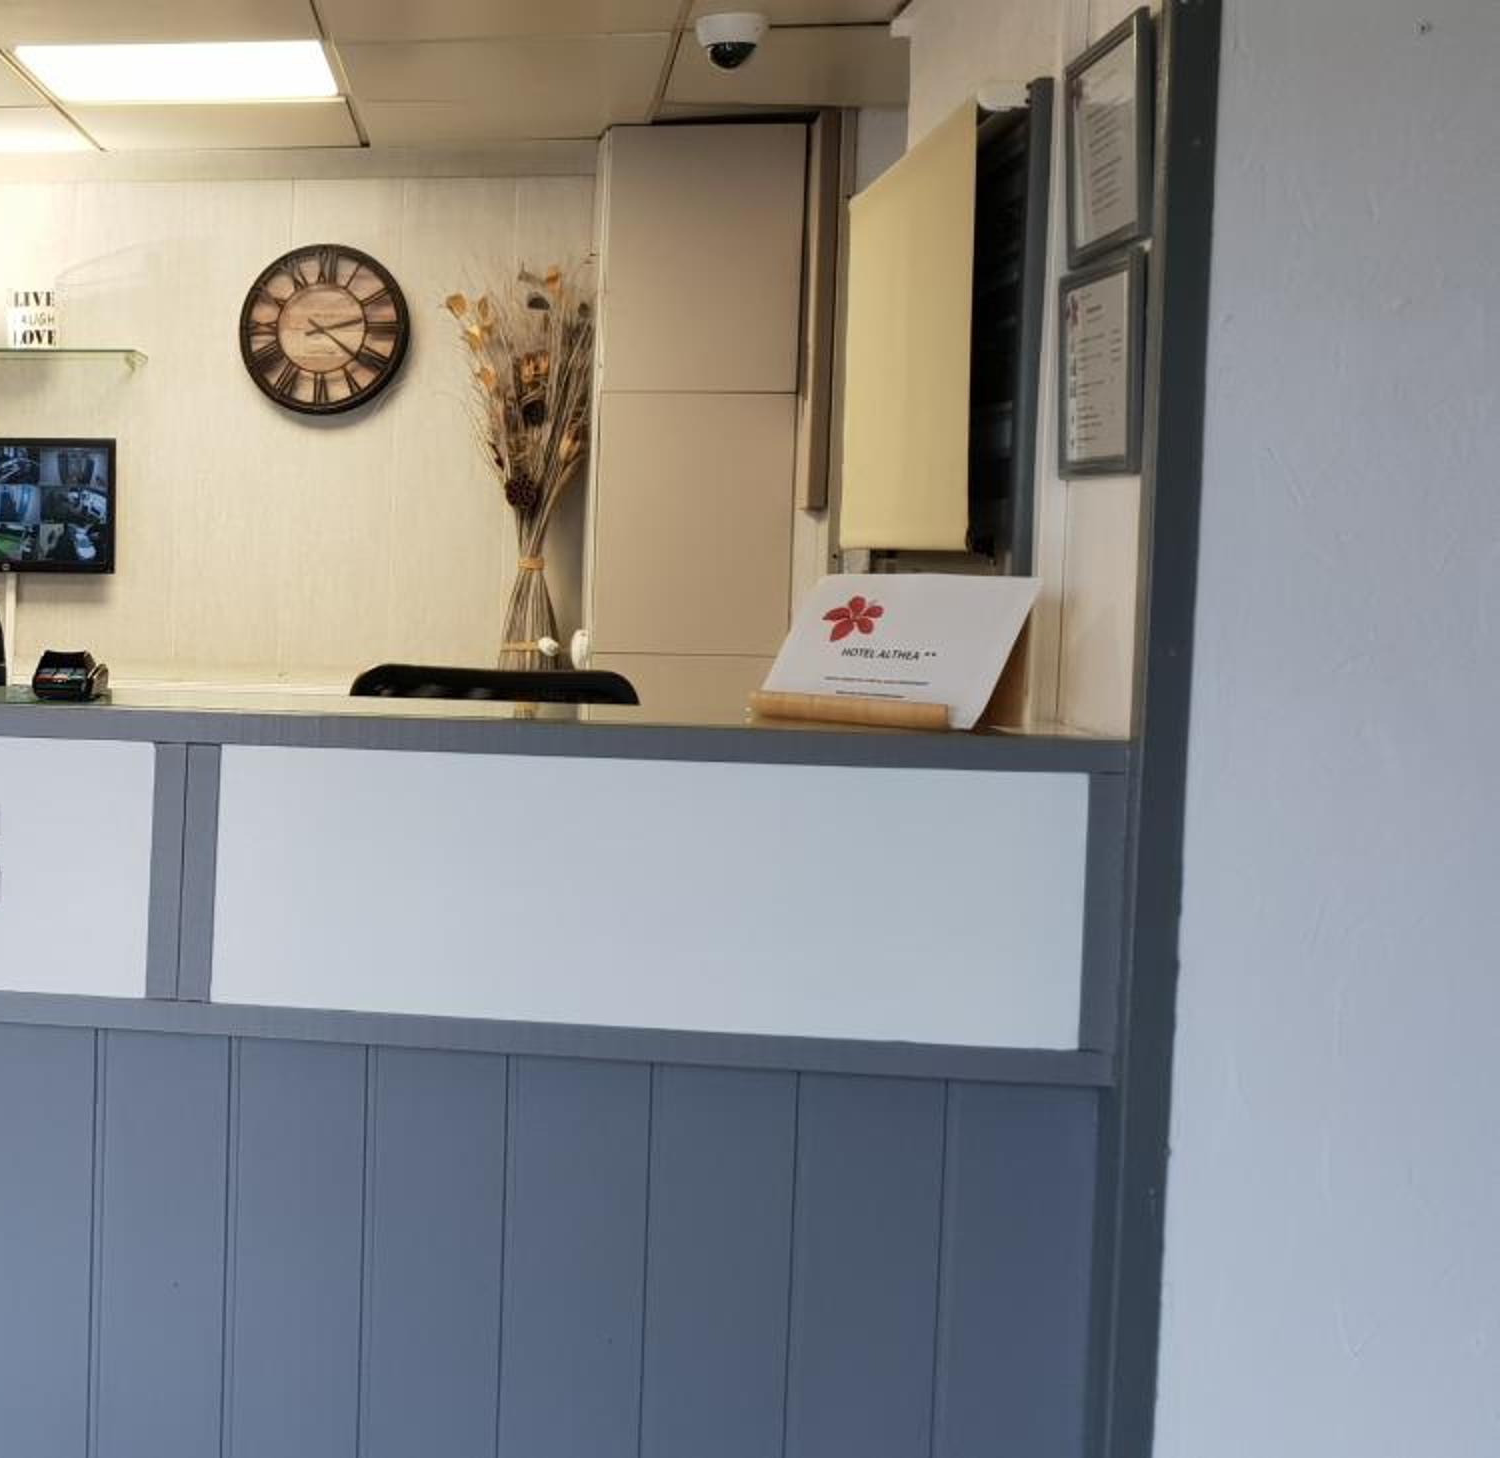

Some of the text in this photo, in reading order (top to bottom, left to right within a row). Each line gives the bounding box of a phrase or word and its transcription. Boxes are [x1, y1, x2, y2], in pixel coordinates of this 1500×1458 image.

[14, 291, 55, 307] LIVE
[14, 312, 54, 327] AUGH
[13, 329, 56, 346] LOVE
[841, 647, 874, 659] HOTEL
